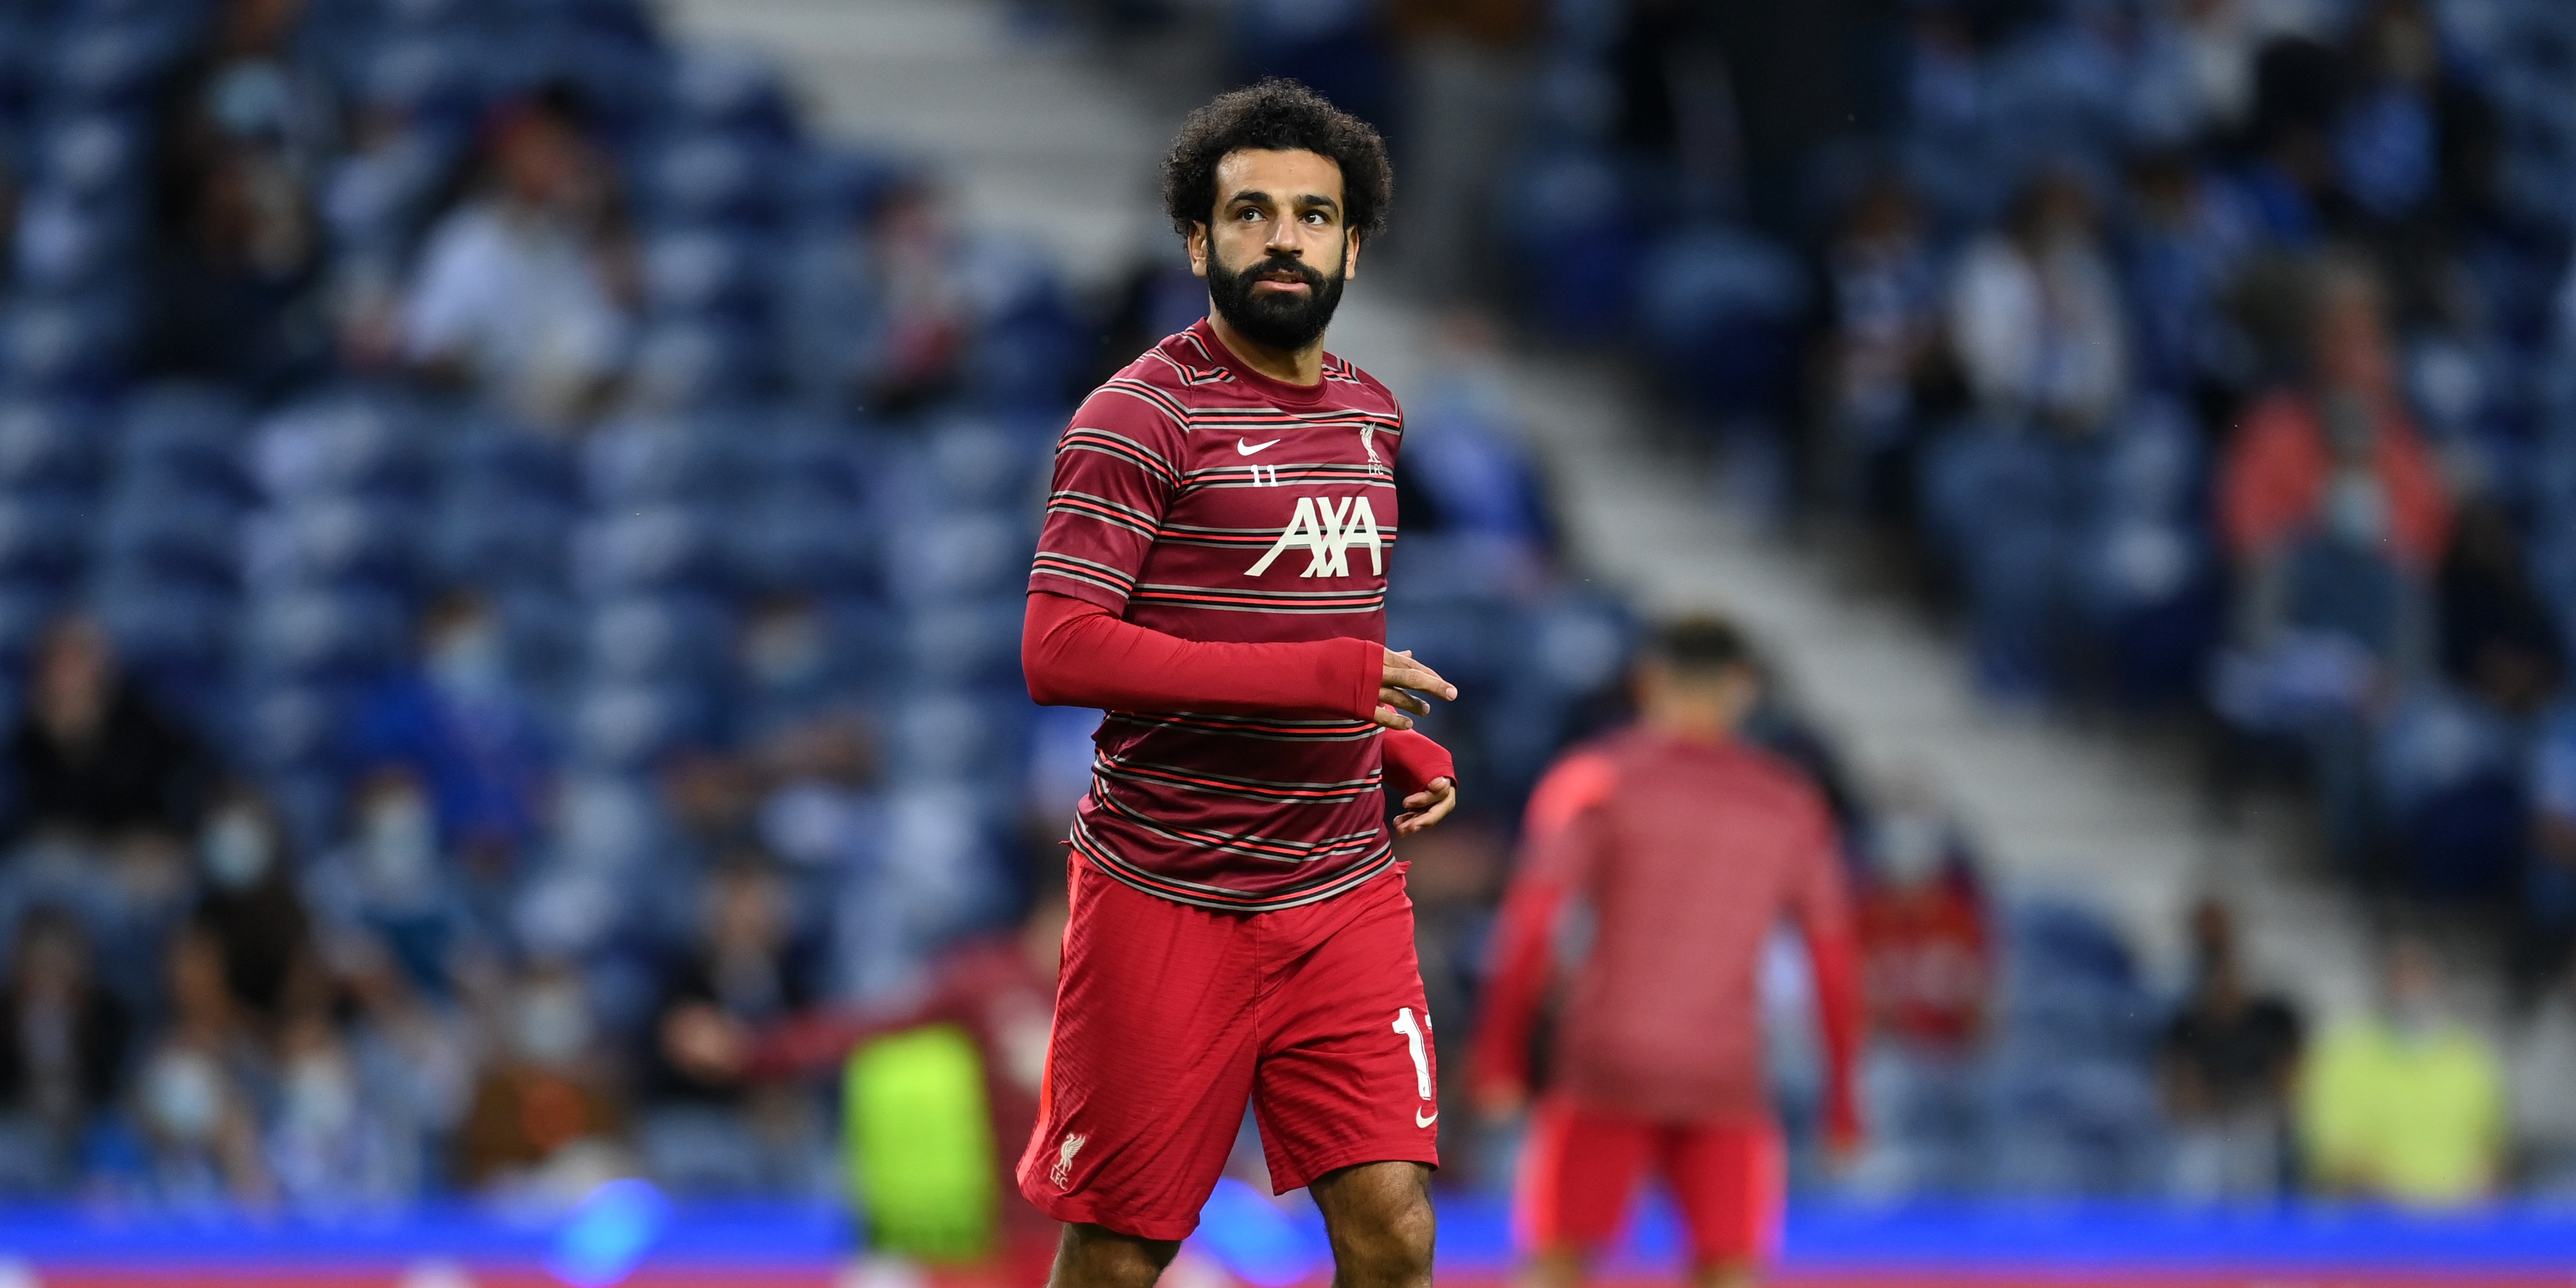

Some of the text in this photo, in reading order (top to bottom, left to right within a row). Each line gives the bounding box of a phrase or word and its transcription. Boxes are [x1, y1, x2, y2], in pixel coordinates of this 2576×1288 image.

[1250, 464, 1279, 487] 11
[1243, 496, 1382, 578] AXA
[1392, 1007, 1432, 1101] 1
